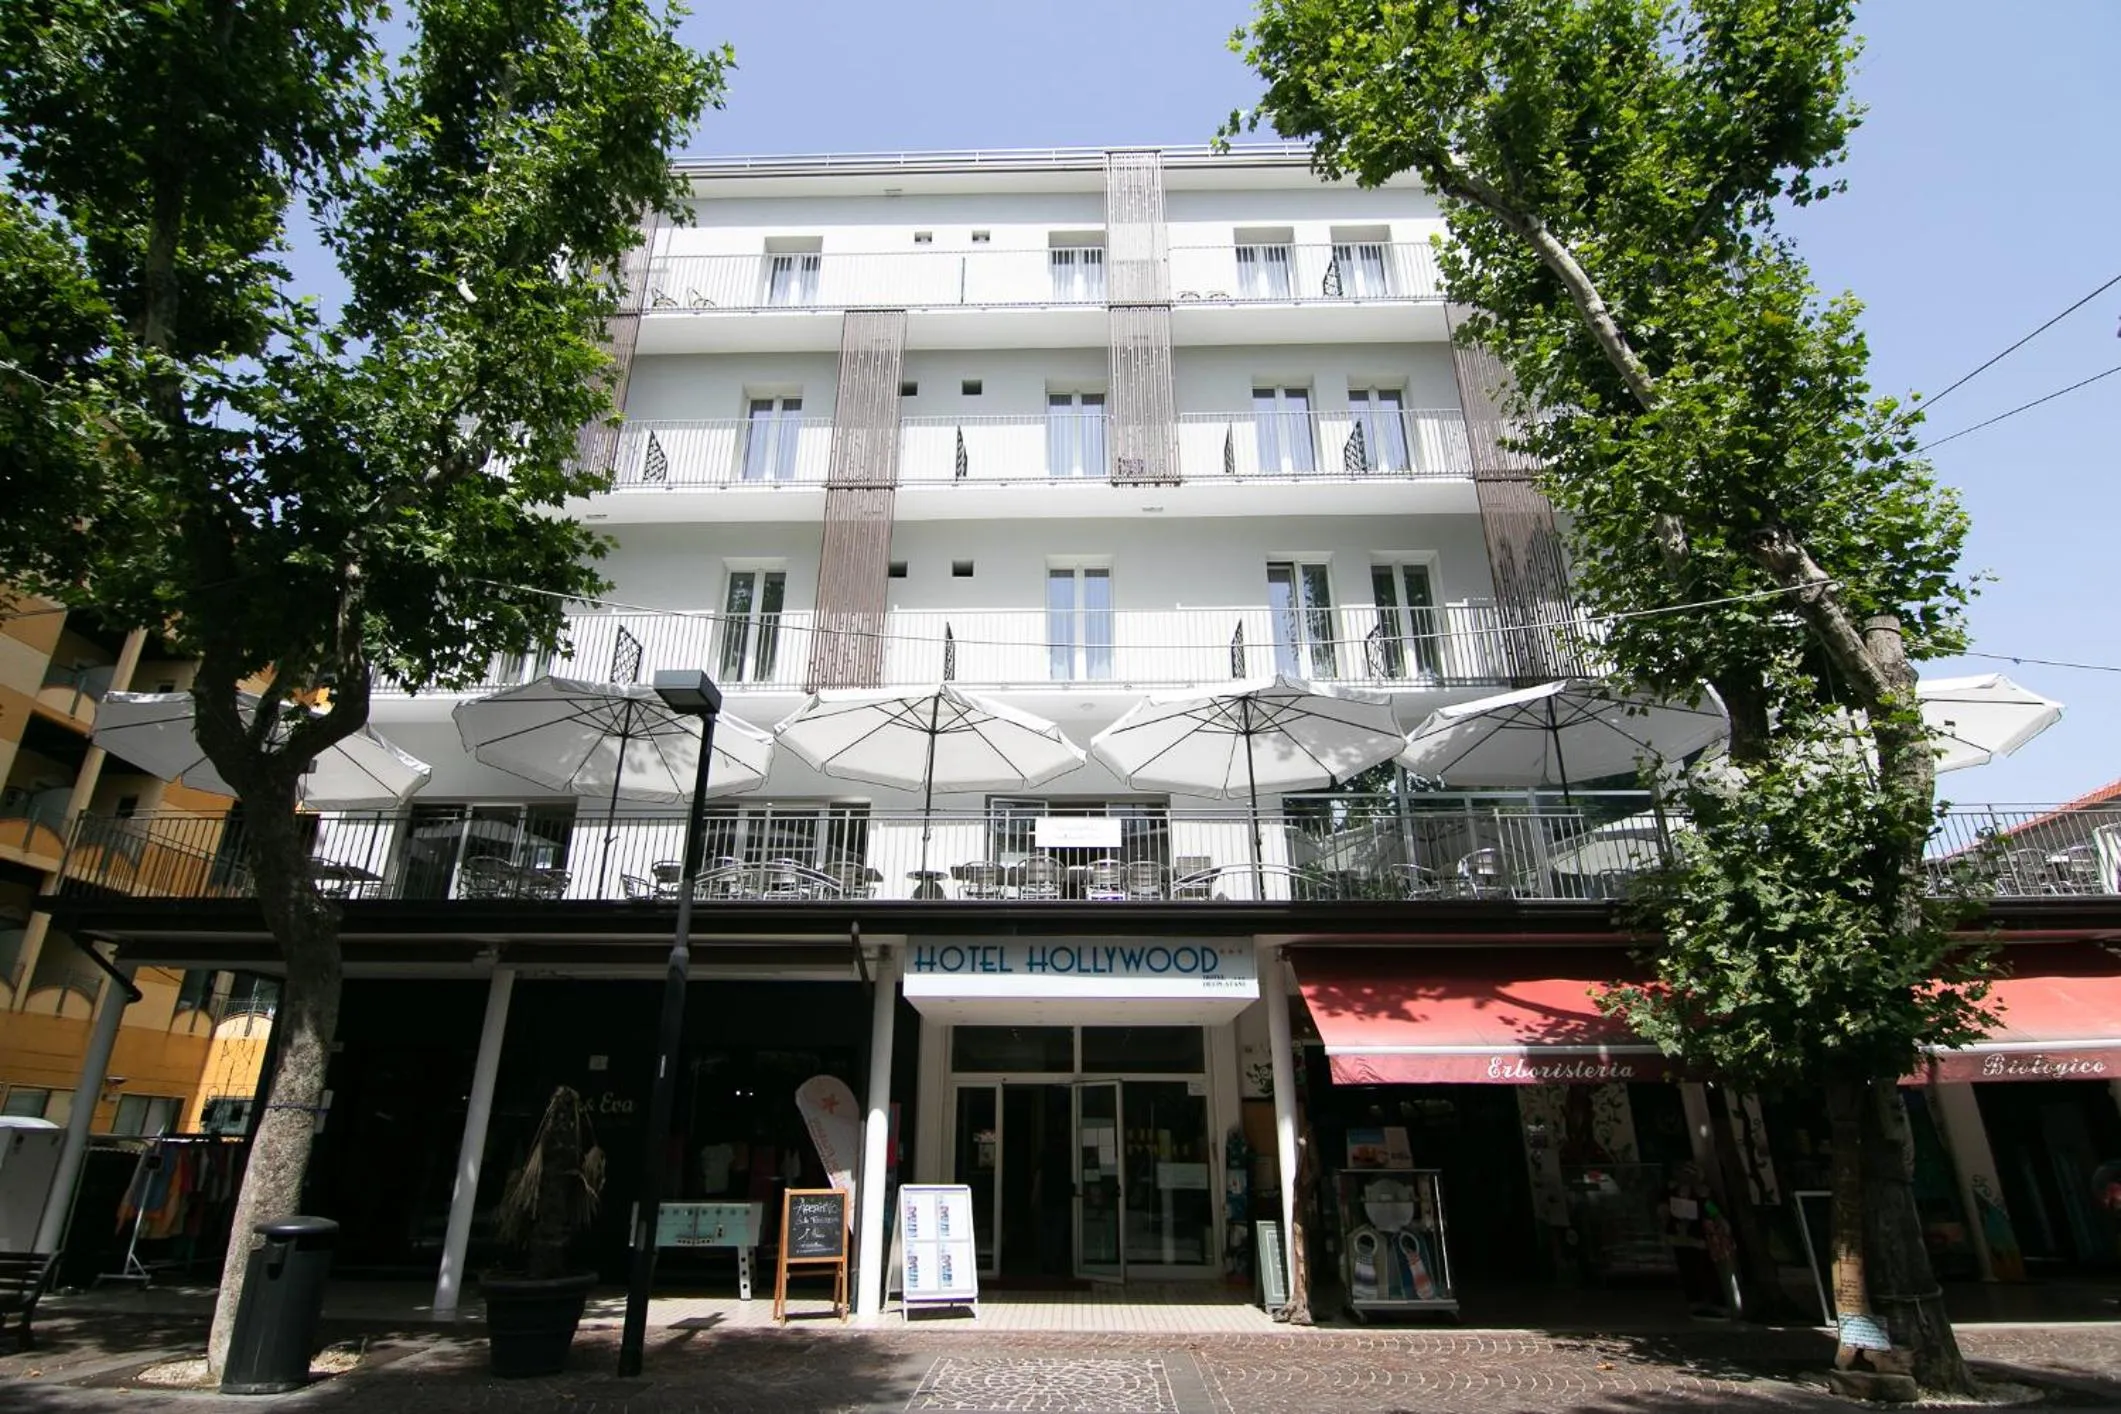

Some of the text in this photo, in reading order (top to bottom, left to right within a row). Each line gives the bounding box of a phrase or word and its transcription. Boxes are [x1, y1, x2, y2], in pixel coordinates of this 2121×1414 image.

[914, 945, 1219, 974] HOTEL HOLLYWOOD
[1487, 1056, 1635, 1079] Erboristeria
[1983, 1052, 2107, 1078] Biologico
[599, 1091, 637, 1114] Eva
